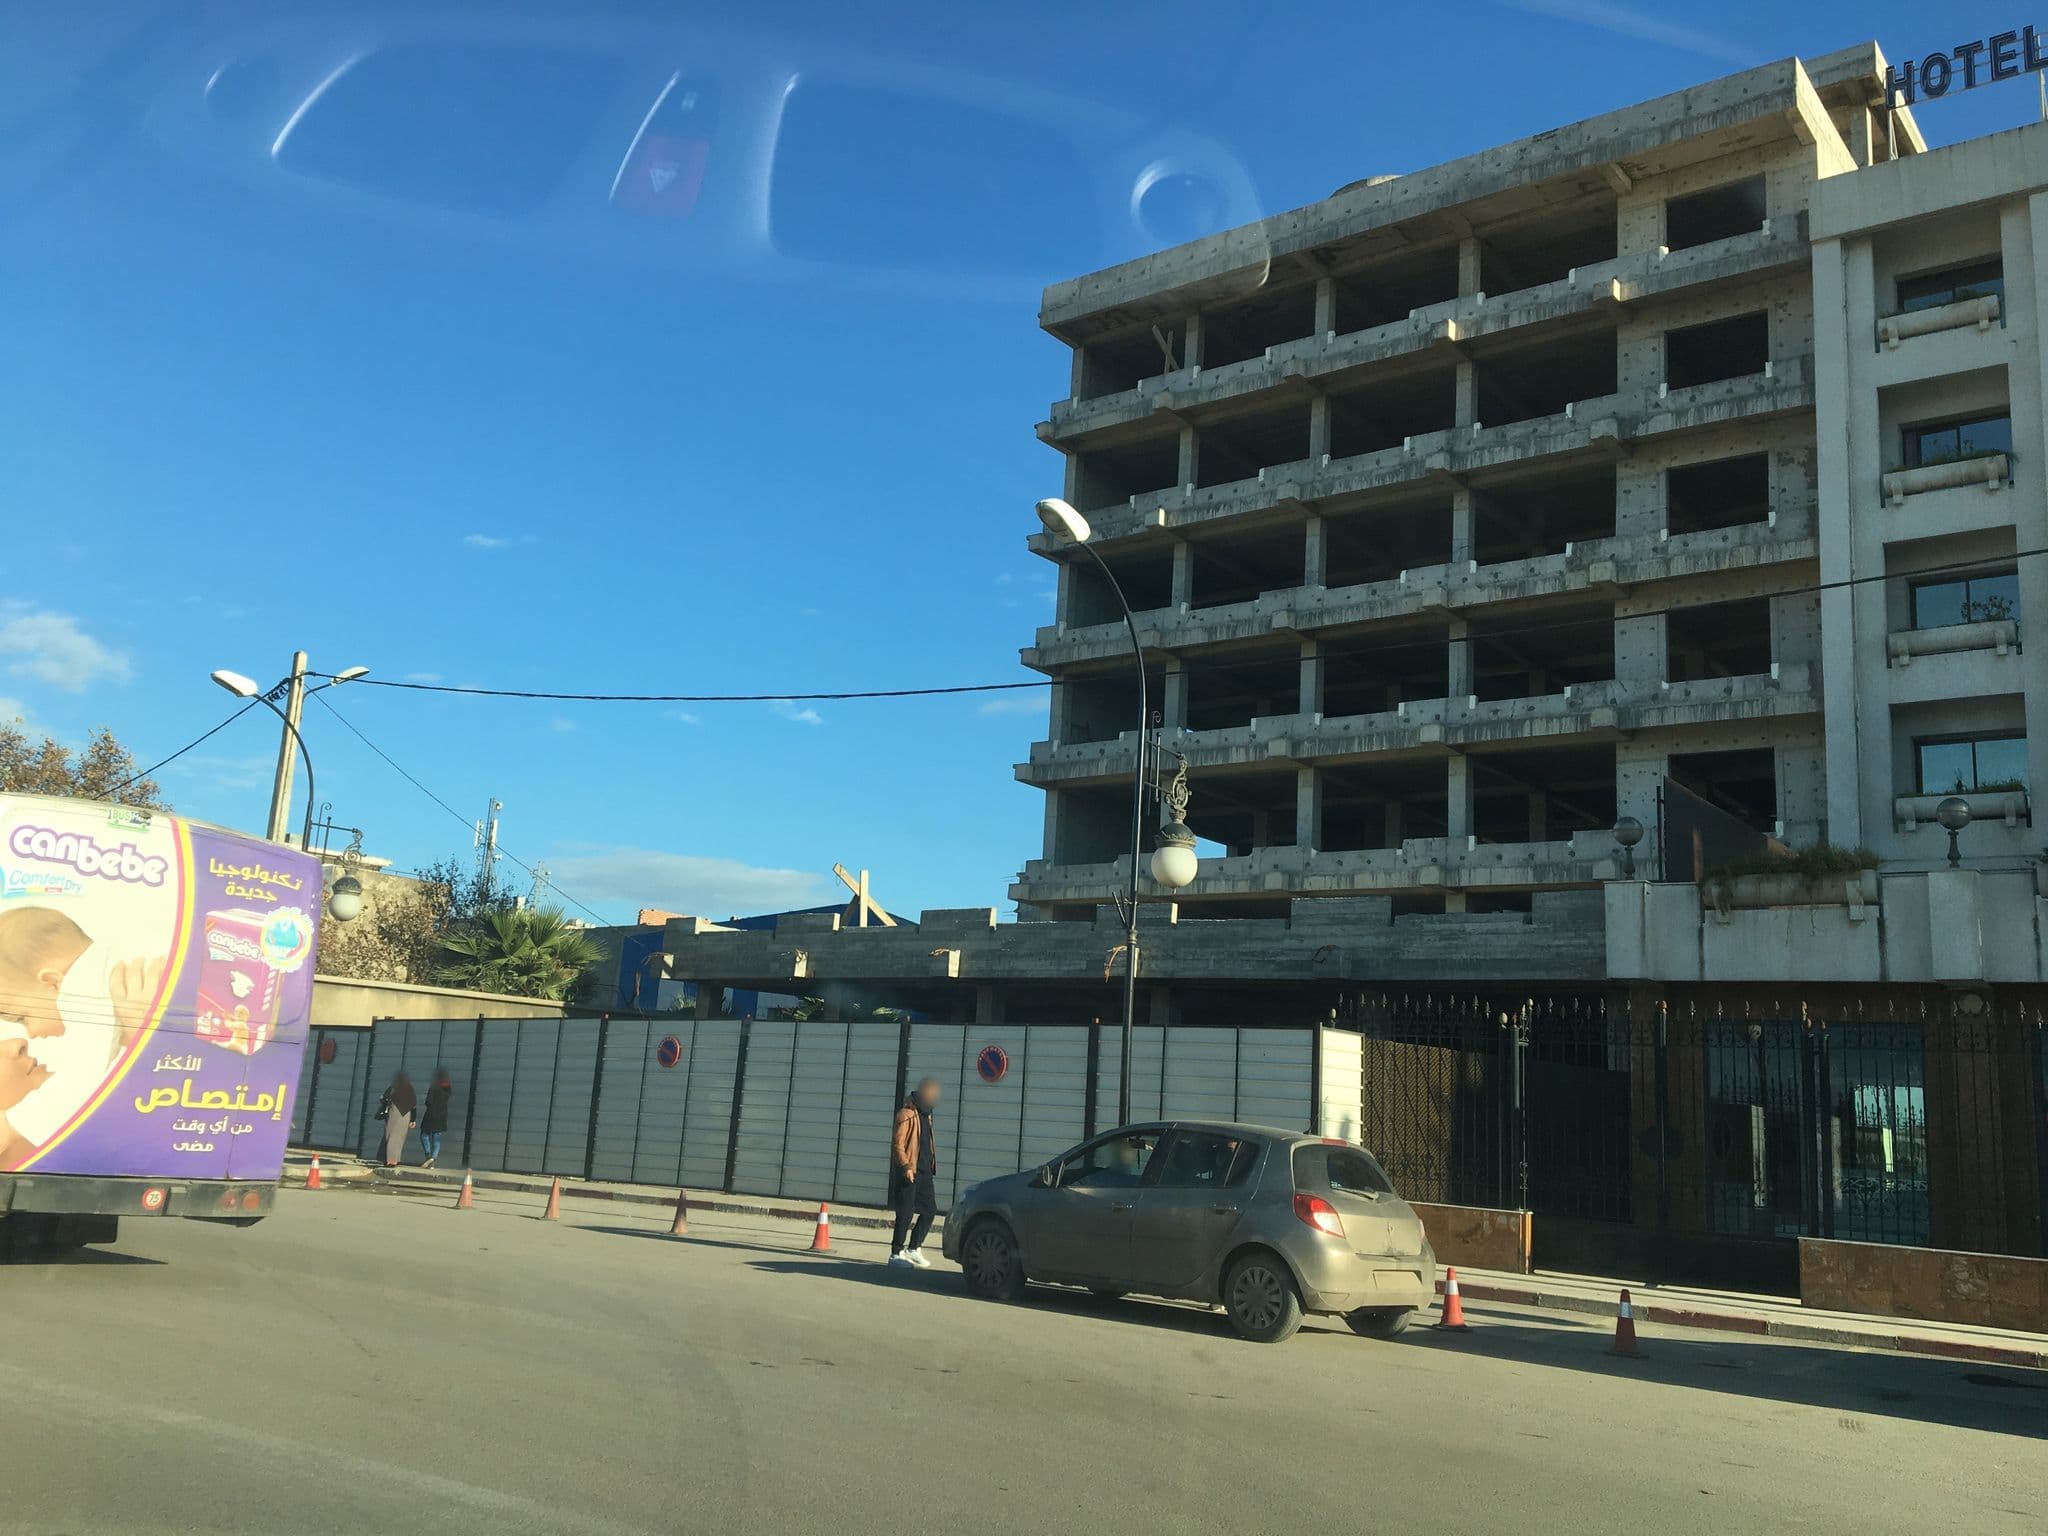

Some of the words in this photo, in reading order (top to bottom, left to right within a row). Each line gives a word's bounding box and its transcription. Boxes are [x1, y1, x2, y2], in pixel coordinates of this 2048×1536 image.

[1885, 25, 2048, 110] HOTEL
[10, 825, 168, 887] canbebe
[209, 858, 303, 890] تكنولوجيا
[225, 881, 277, 902] جديدة
[152, 1053, 202, 1072] الأكثر
[134, 1078, 287, 1121] إمتصاص
[172, 1118, 206, 1135] وقت
[209, 1115, 228, 1135] أي
[230, 1121, 253, 1135] من
